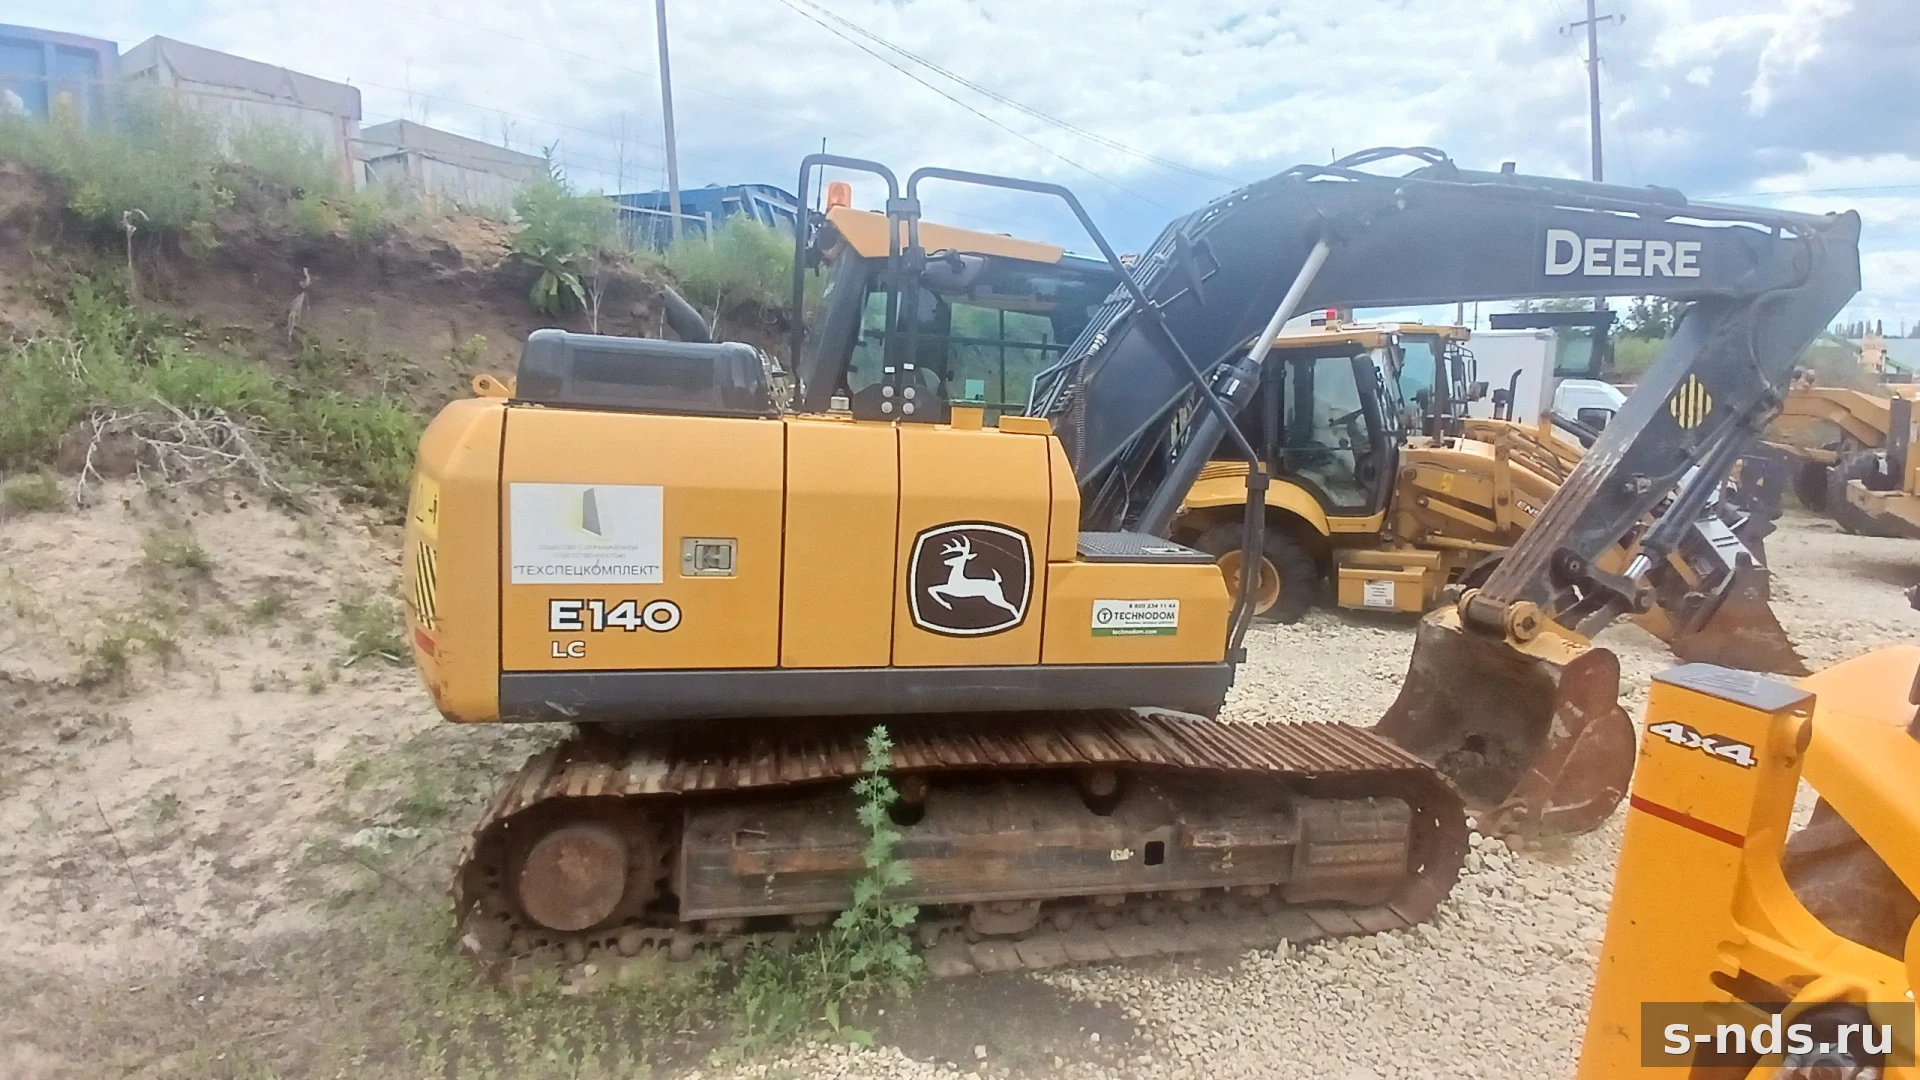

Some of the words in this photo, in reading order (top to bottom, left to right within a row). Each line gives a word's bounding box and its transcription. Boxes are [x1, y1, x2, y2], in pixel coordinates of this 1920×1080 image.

[1545, 229, 1702, 277] DEERE
[513, 565, 660, 577] "ТЕХСПЕЦКОМПЛЕКТ"
[549, 599, 682, 633] E140
[1114, 611, 1175, 620] TECHNODOM
[552, 641, 586, 658] LC
